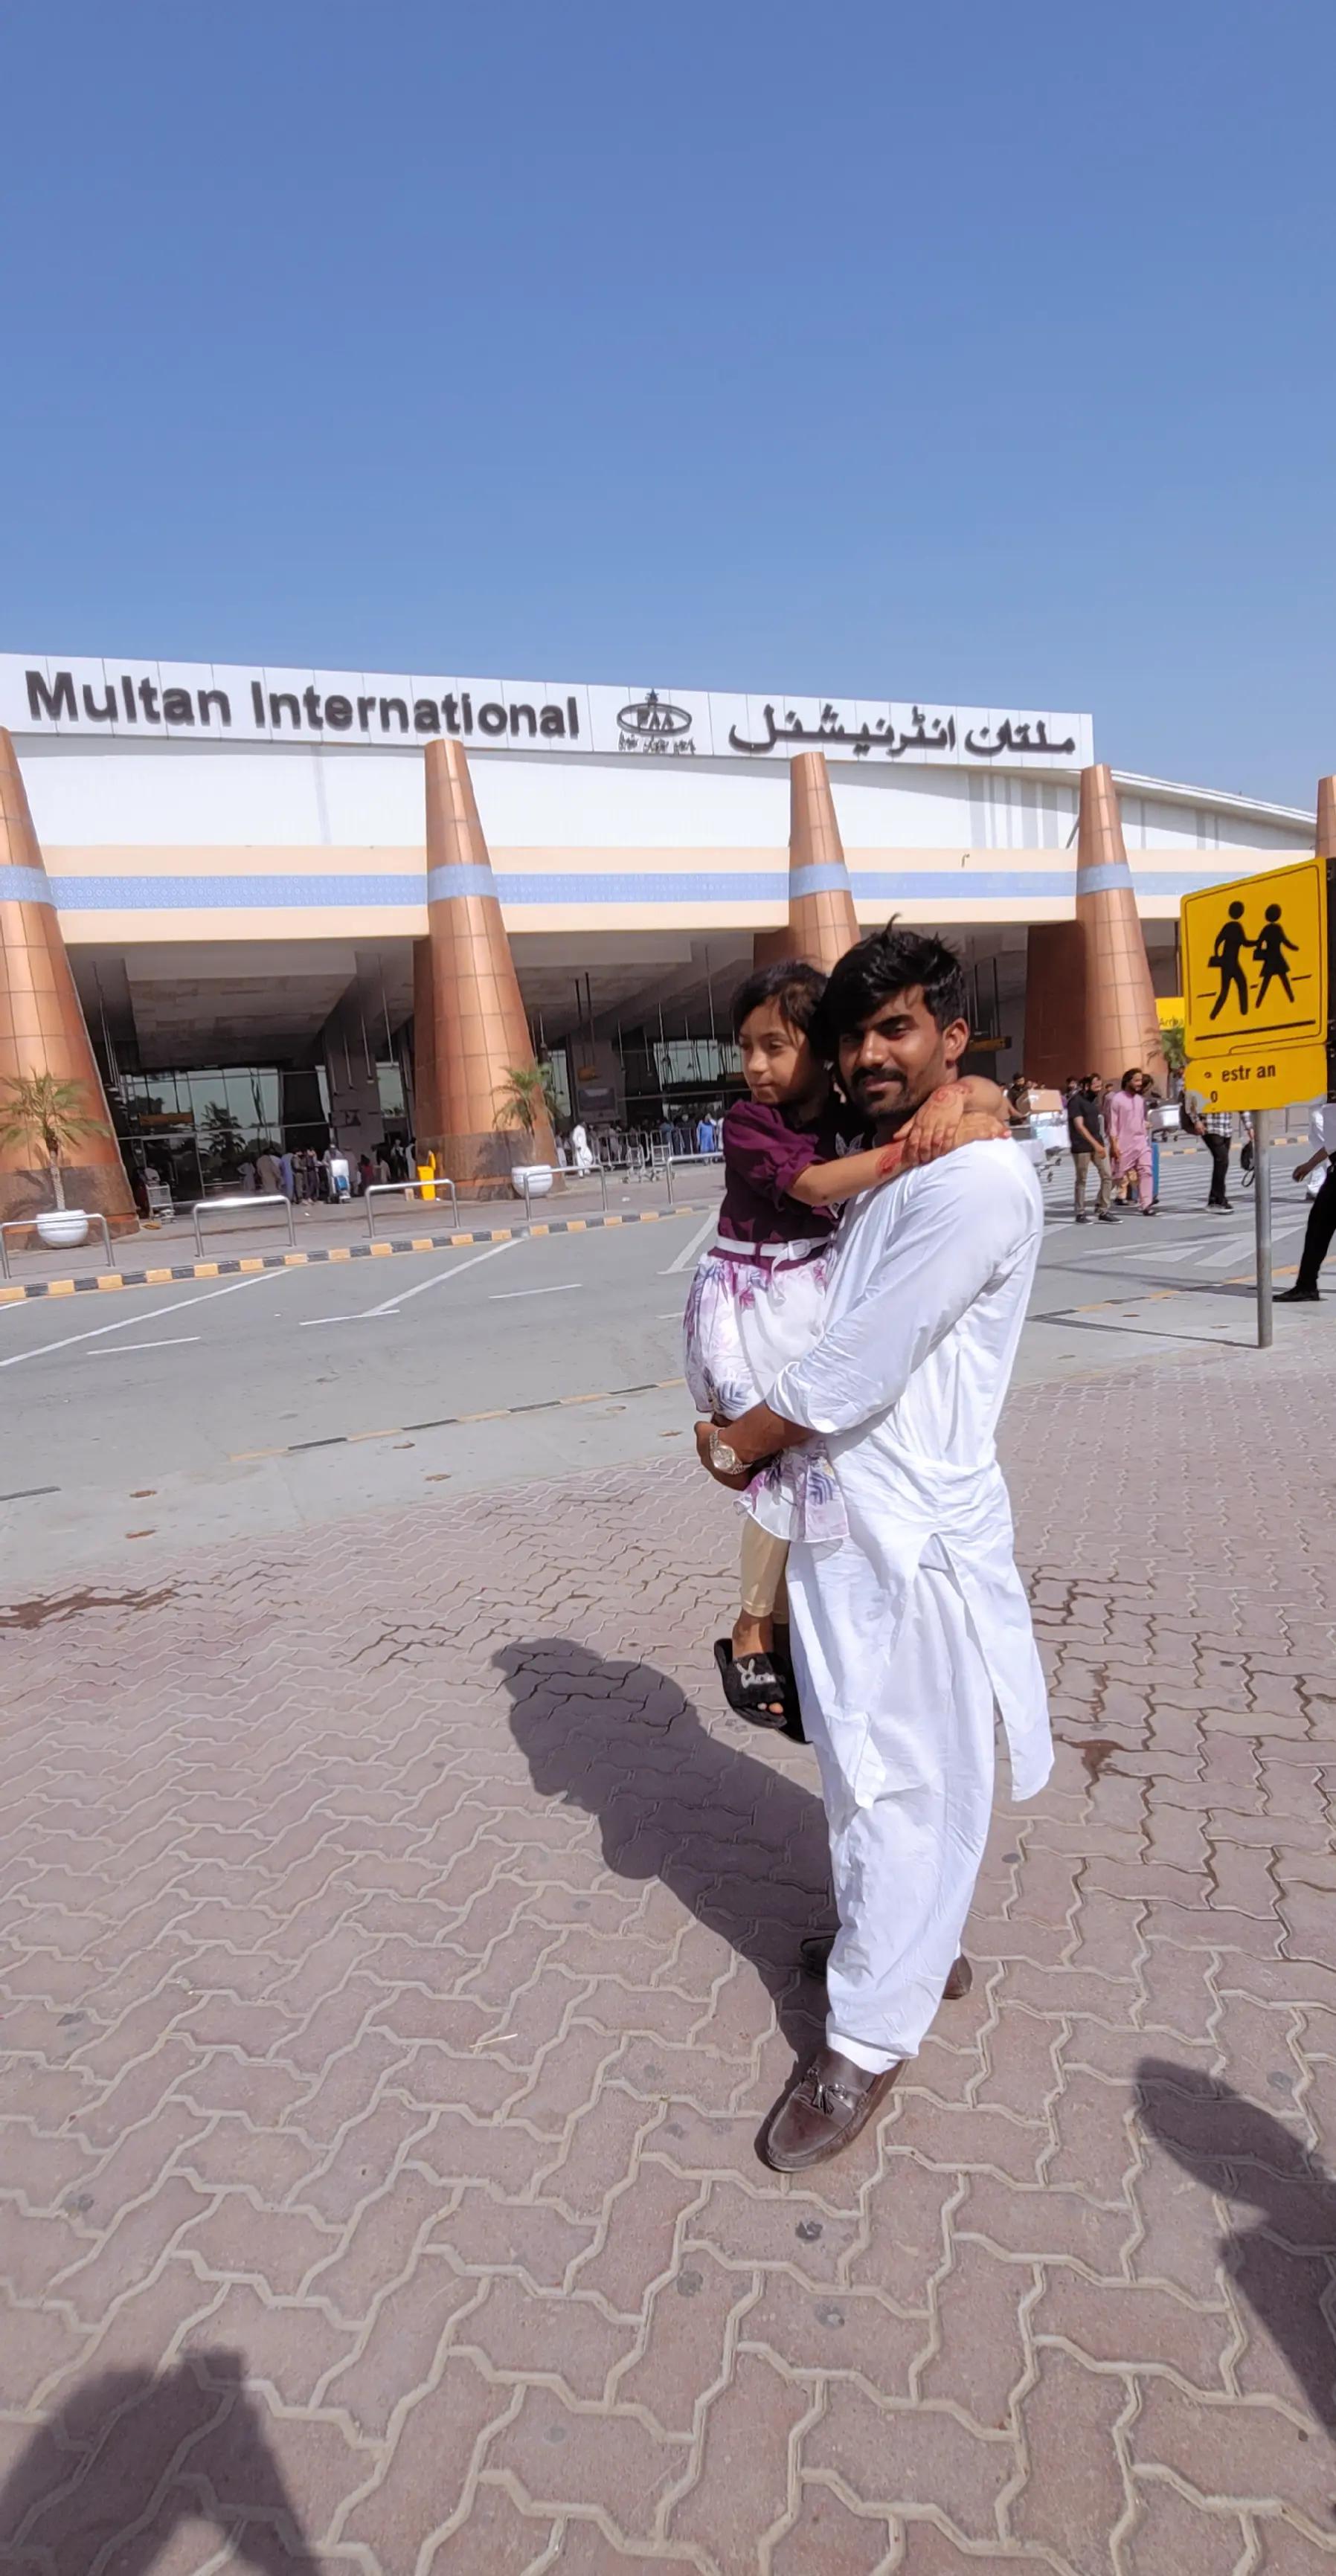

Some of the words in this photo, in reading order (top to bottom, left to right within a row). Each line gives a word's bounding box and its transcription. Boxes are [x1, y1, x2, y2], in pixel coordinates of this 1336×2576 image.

[25, 671, 231, 726] Multan
[251, 681, 579, 738] International
[728, 704, 955, 754] انٹرنیشنل
[964, 718, 1076, 756] ملتان
